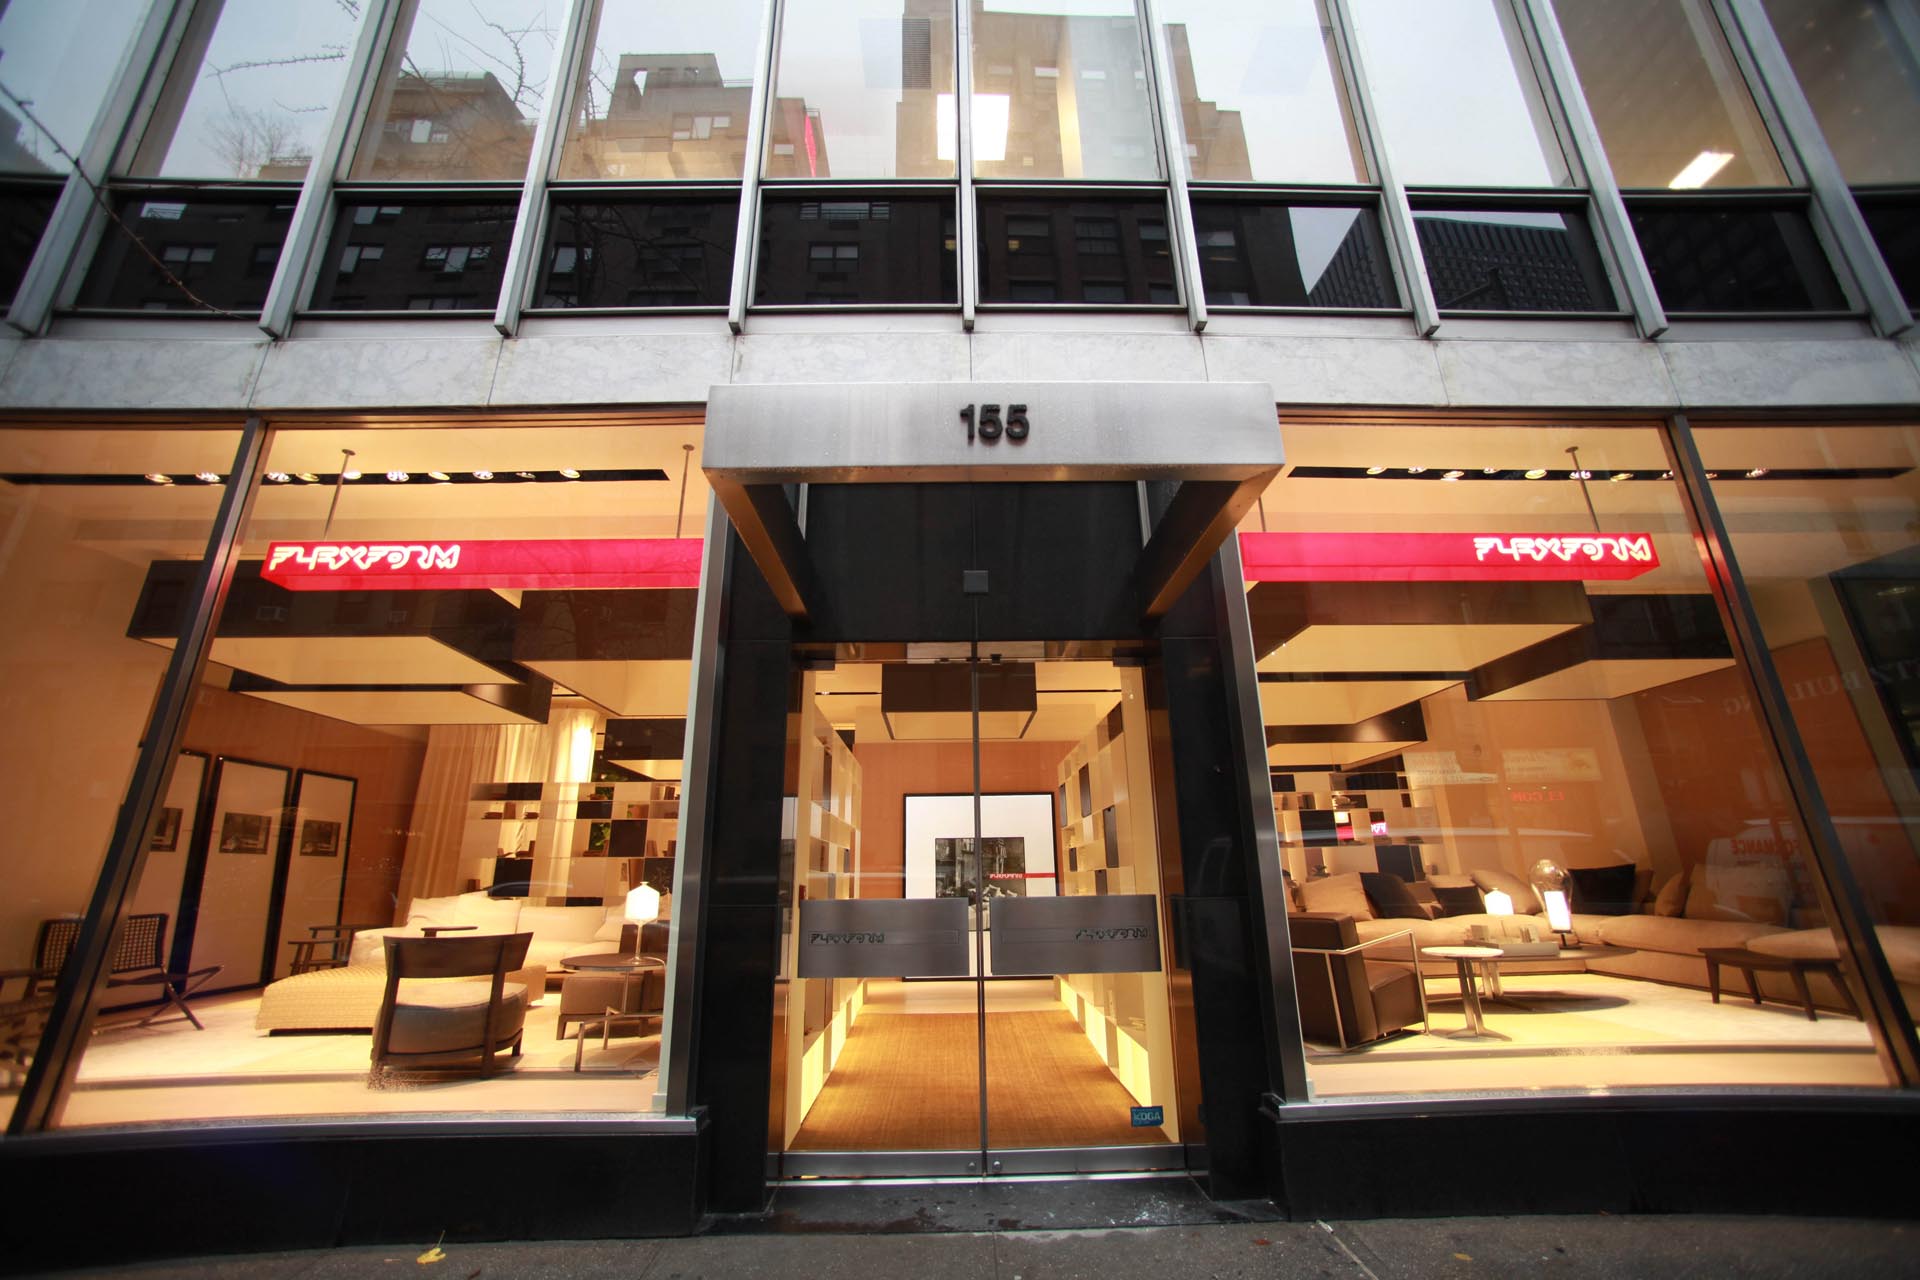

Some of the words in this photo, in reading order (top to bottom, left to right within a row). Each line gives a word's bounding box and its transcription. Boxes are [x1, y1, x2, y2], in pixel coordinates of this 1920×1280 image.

[959, 403, 1030, 447] 155
[267, 543, 461, 571] FLEXFORM
[1473, 537, 1652, 562] FLEXFORM
